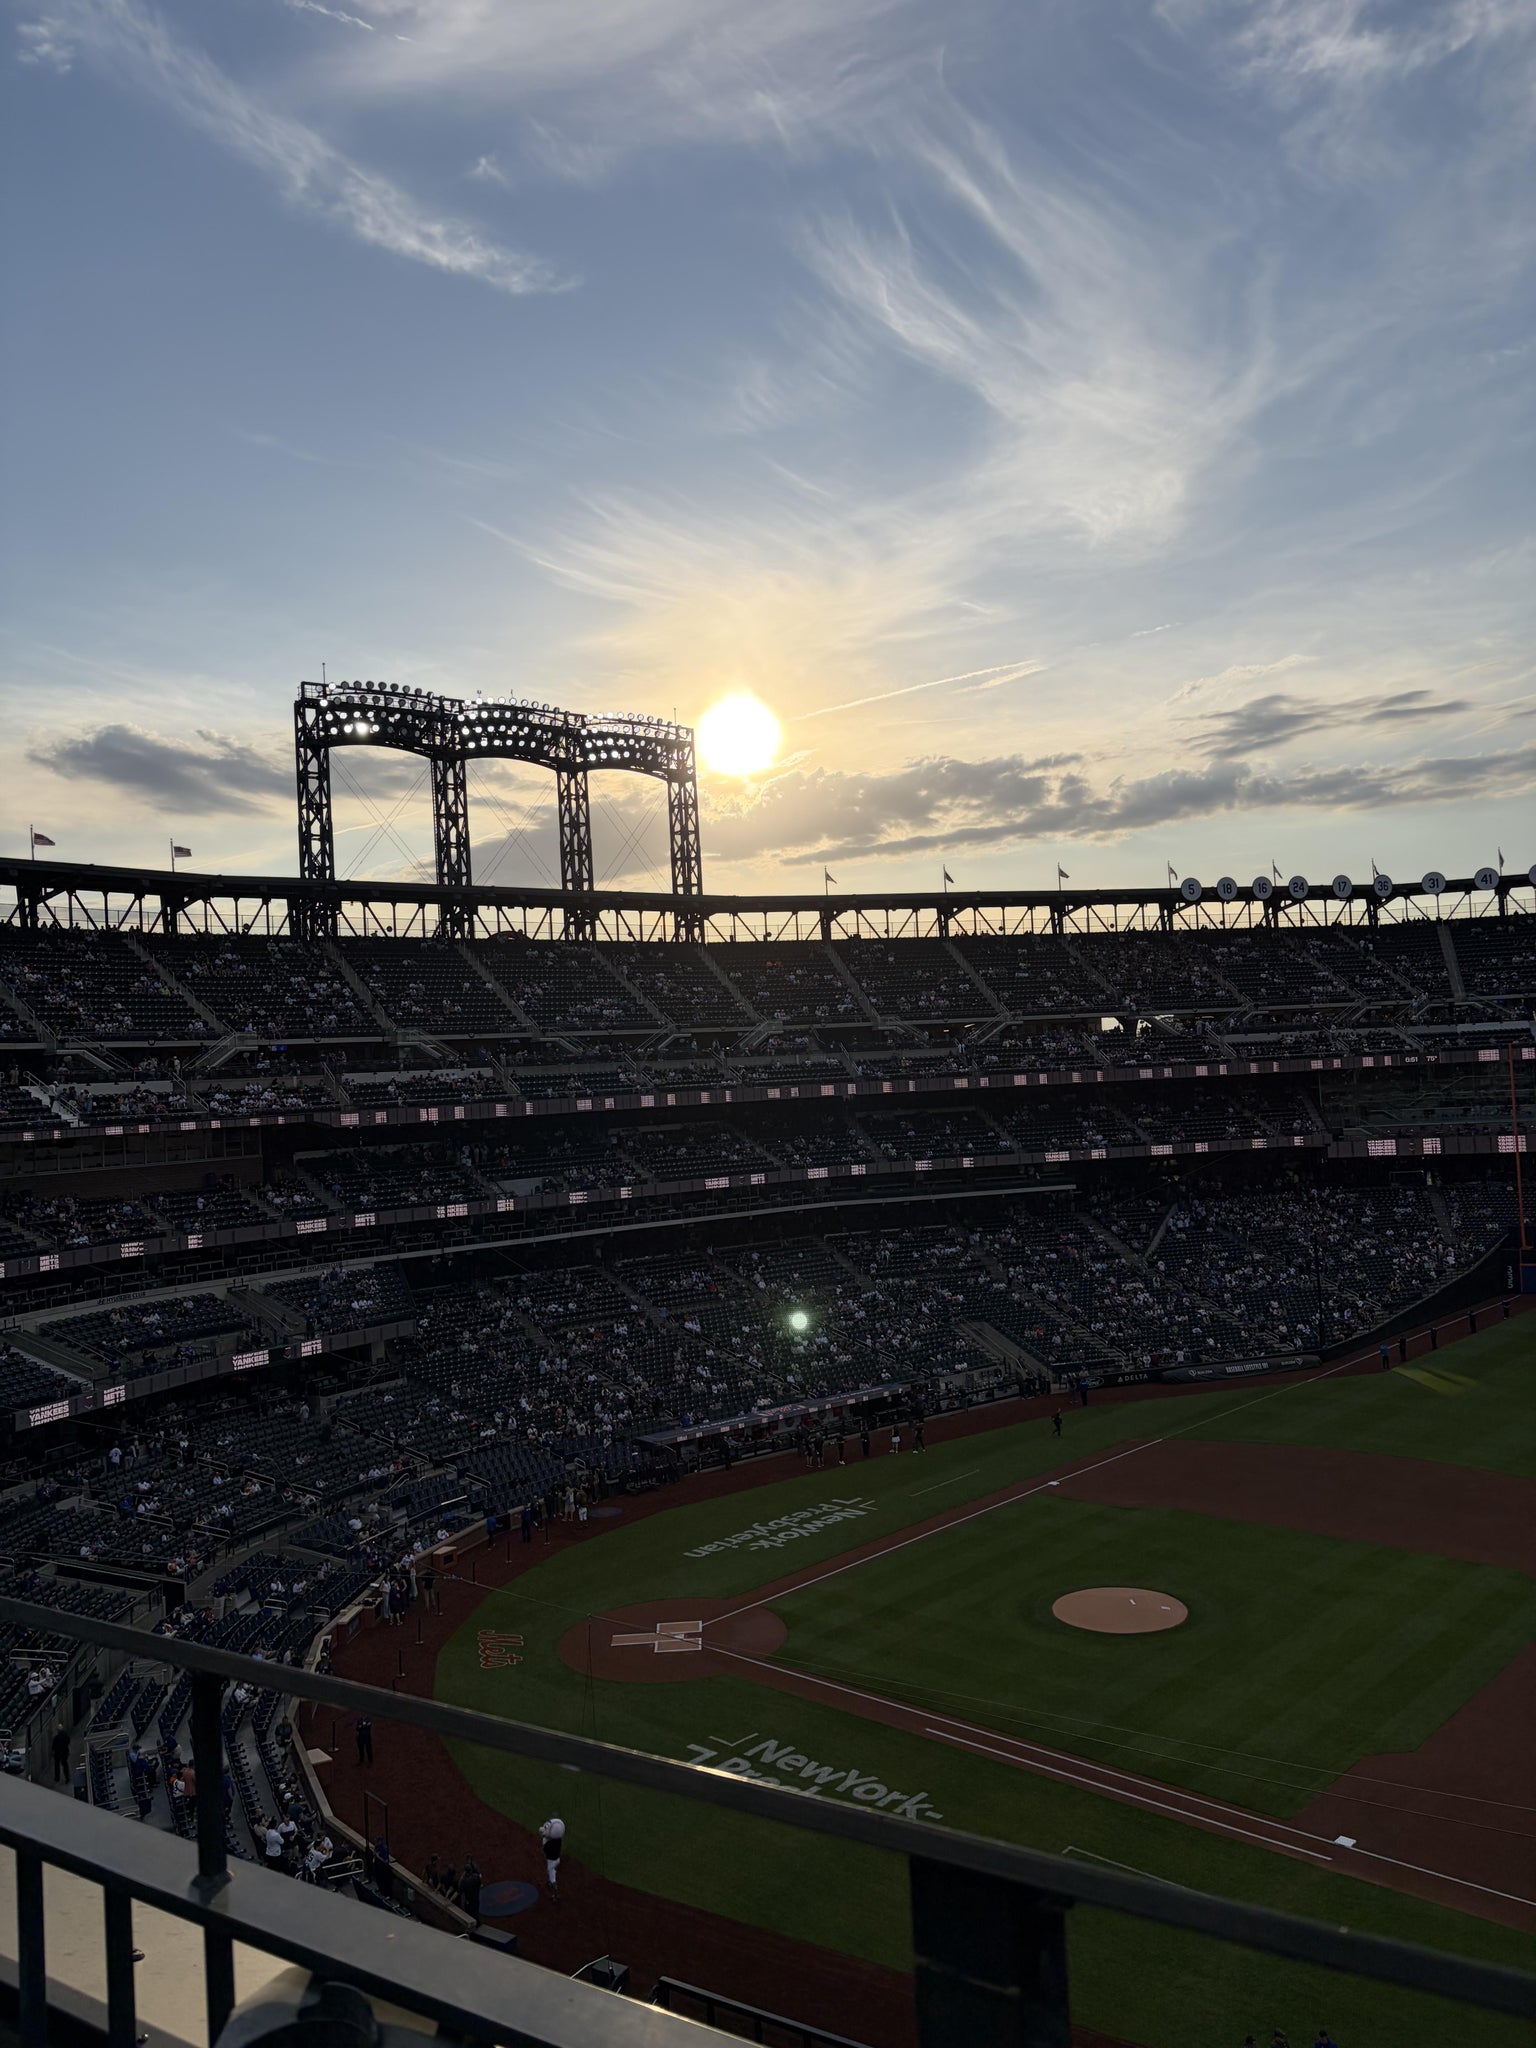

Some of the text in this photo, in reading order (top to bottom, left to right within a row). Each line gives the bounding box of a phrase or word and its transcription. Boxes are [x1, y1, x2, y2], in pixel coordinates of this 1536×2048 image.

[1428, 878, 1440, 889] 31
[1480, 873, 1493, 885] 41
[1188, 884, 1195, 895] 5
[1222, 883, 1232, 894] 18
[1258, 882, 1268, 893] 16
[1293, 881, 1305, 893] 24
[1337, 881, 1347, 892] 17
[1377, 880, 1389, 891] 36
[295, 1219, 327, 1233] YANKEES
[232, 1342, 323, 1369] YANKEES METS
[1124, 1373, 1149, 1382] DELTA
[29, 1387, 126, 1425] YANKEES METS
[683, 1503, 842, 1558] Presbyterian
[477, 1629, 524, 1669] Mets
